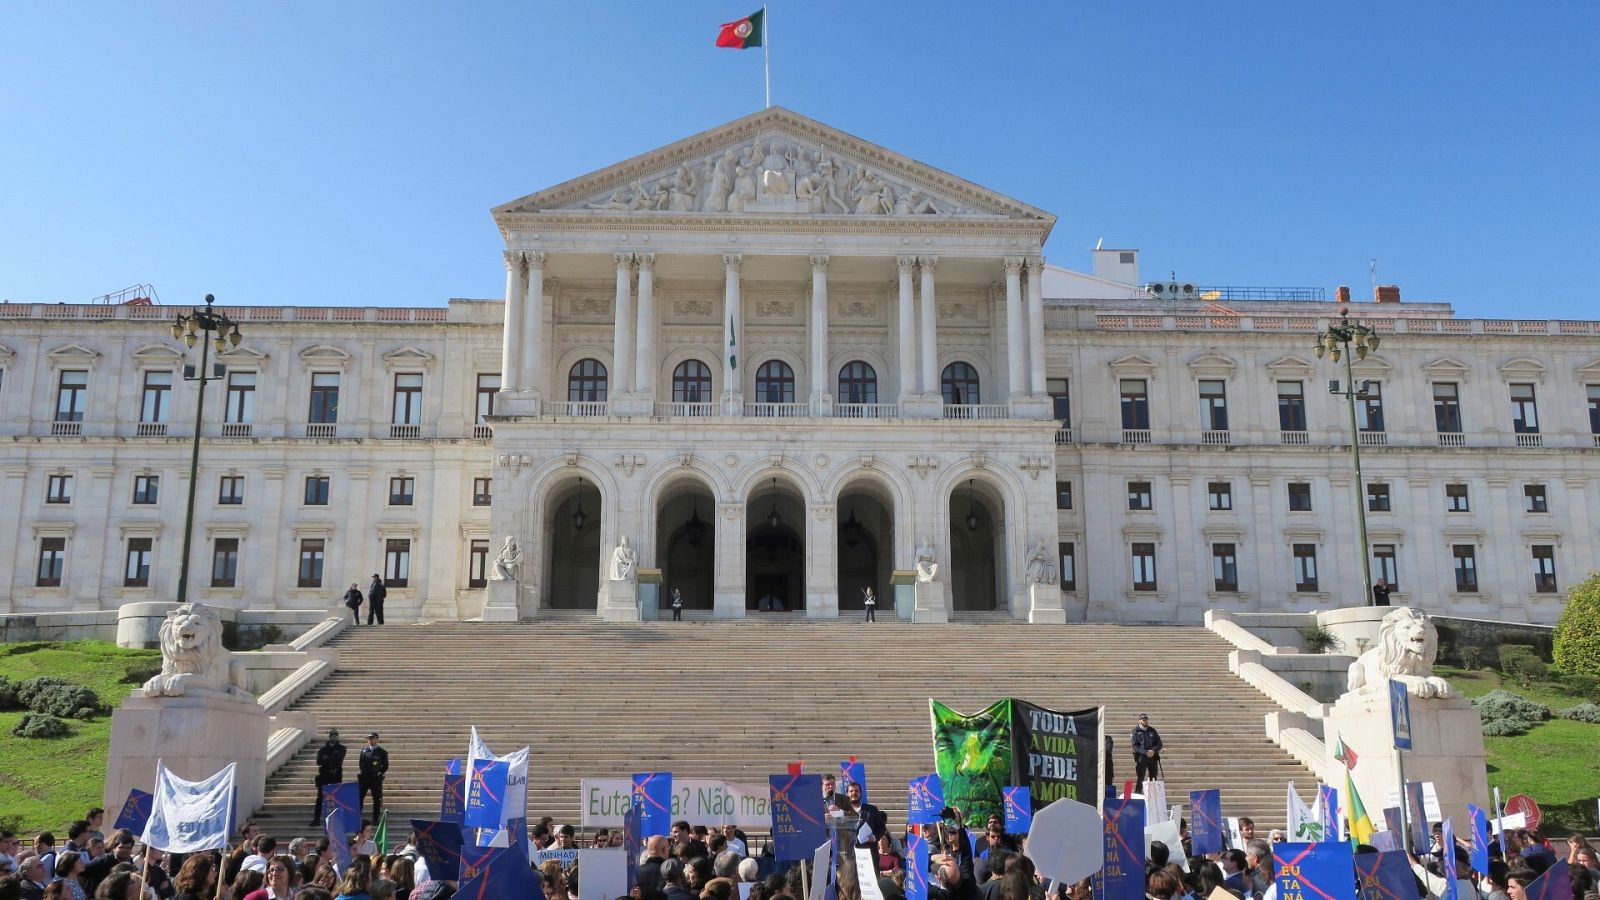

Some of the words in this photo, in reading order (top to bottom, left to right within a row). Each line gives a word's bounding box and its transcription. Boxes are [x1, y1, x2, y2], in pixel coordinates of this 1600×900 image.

[1029, 710, 1078, 736] TODA
[1030, 733, 1040, 751] A
[1043, 735, 1077, 756] VIDA
[1028, 753, 1078, 782] PEDE
[775, 793, 789, 801] EU
[1029, 780, 1077, 802] AMOR
[698, 786, 735, 816] Não
[740, 795, 772, 816] ma
[775, 803, 789, 812] TA
[1105, 823, 1119, 834] EU
[1106, 837, 1118, 848] TA
[1281, 865, 1301, 877] EU
[1282, 879, 1301, 890] TA
[1365, 875, 1380, 887] EU
[1369, 889, 1384, 900] TA
